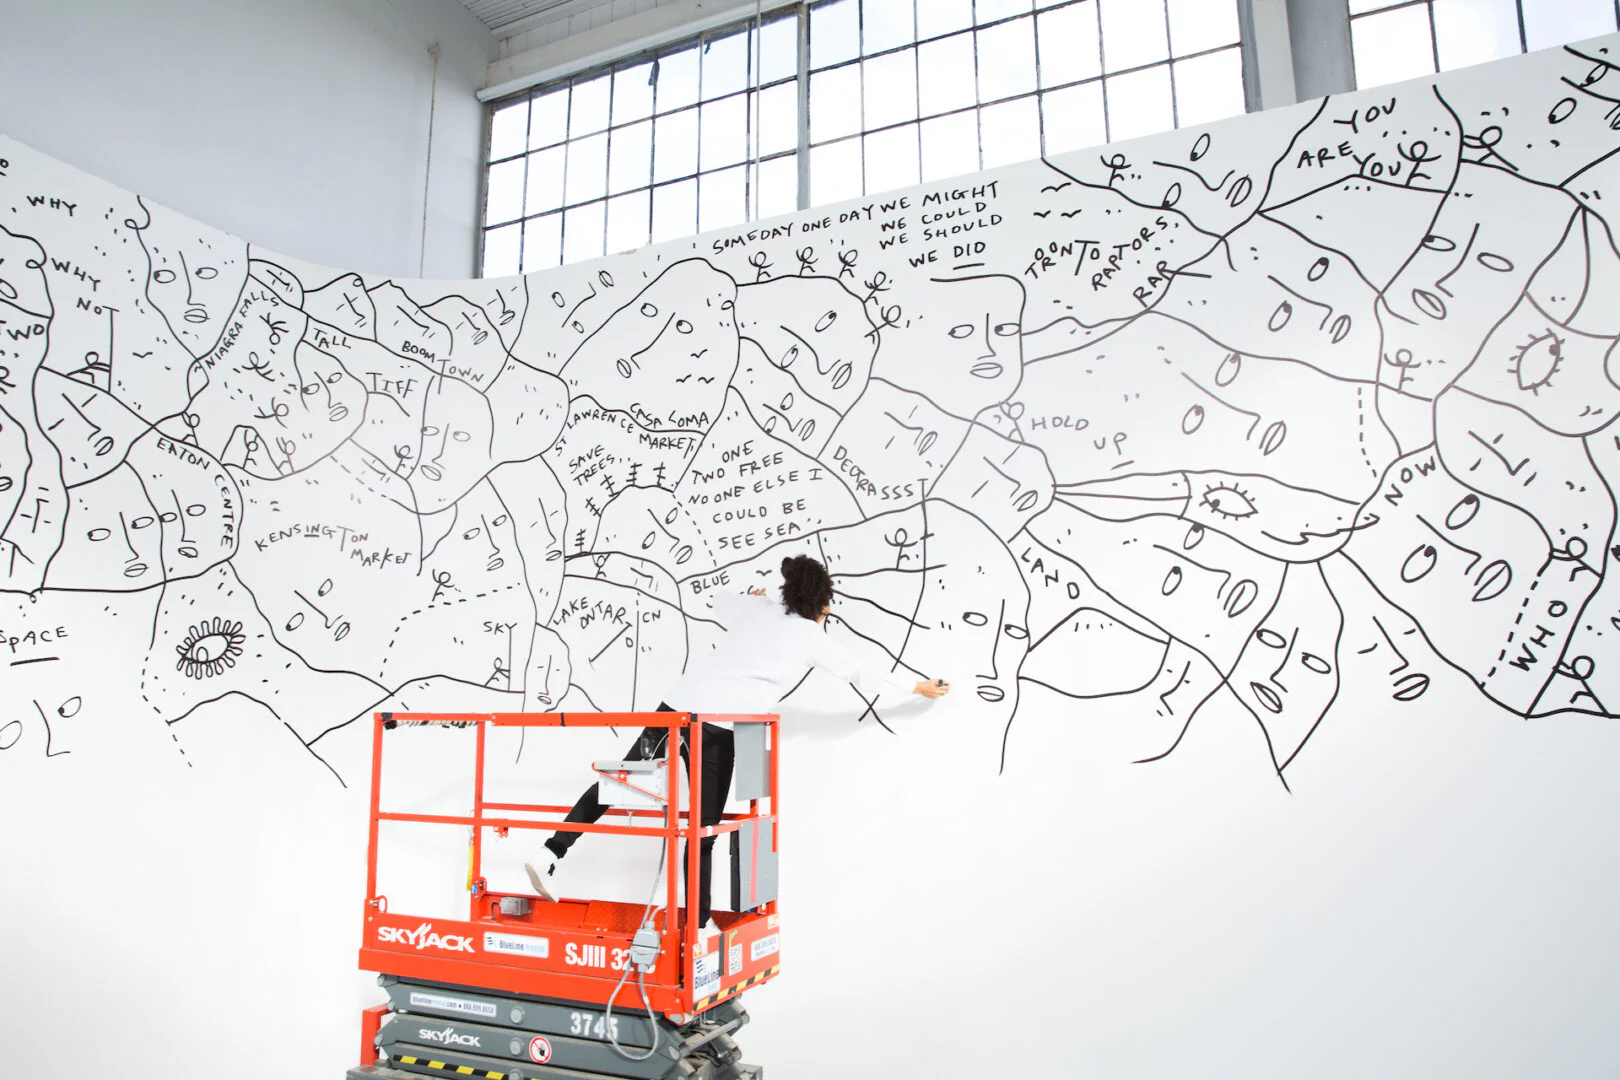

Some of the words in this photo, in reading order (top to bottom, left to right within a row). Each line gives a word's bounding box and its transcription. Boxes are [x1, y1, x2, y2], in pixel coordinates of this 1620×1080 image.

[1333, 97, 1396, 134] YOU
[1297, 141, 1353, 168] ARE
[1352, 153, 1401, 177] YOU
[26, 195, 77, 217] WHY
[713, 222, 794, 255] SOMEDAY
[802, 217, 831, 233] ONE
[839, 204, 875, 224] DAY
[880, 197, 911, 213] WE
[922, 180, 999, 207] MIGHT
[881, 217, 906, 233] WE
[922, 201, 987, 225] COULD
[879, 234, 909, 250] WE
[924, 214, 1002, 242] SHOULD
[909, 250, 938, 268] WE
[953, 241, 986, 258] DID
[1092, 216, 1168, 292] RAPTORS
[51, 257, 101, 292] WHY
[205, 322, 243, 370] NIAGRA
[239, 291, 279, 318] FALLS
[313, 328, 351, 349] TALL
[402, 340, 435, 363] BOOM
[366, 372, 418, 399] TIFF
[630, 403, 662, 429] CASA
[668, 410, 709, 428] LOMA
[1031, 415, 1089, 431] HOLD
[566, 409, 634, 434] LAWRENCE
[639, 433, 697, 459] MARKET
[1093, 432, 1127, 456] UP
[569, 445, 605, 474] SAVE
[722, 440, 754, 463] ONE
[692, 469, 725, 485] TWO
[739, 451, 783, 477] FREE
[753, 470, 799, 493] ELSE
[808, 468, 823, 480] I
[1384, 456, 1436, 507] NOW
[157, 437, 210, 470] EATON
[214, 474, 235, 549] CENTRE
[713, 506, 767, 523] COULD
[782, 498, 807, 515] BE
[255, 523, 369, 552] KENSINGTON
[718, 533, 755, 549] SEE
[764, 522, 801, 540] SEA
[351, 547, 412, 569] MARKET
[690, 570, 731, 594] BLUE
[1021, 547, 1080, 600] LAND
[553, 597, 589, 626] LAKE
[642, 610, 661, 623] CN
[1509, 600, 1568, 671] WHO
[377, 922, 475, 953] SKYJACK
[418, 1027, 481, 1047] SKYJACK
